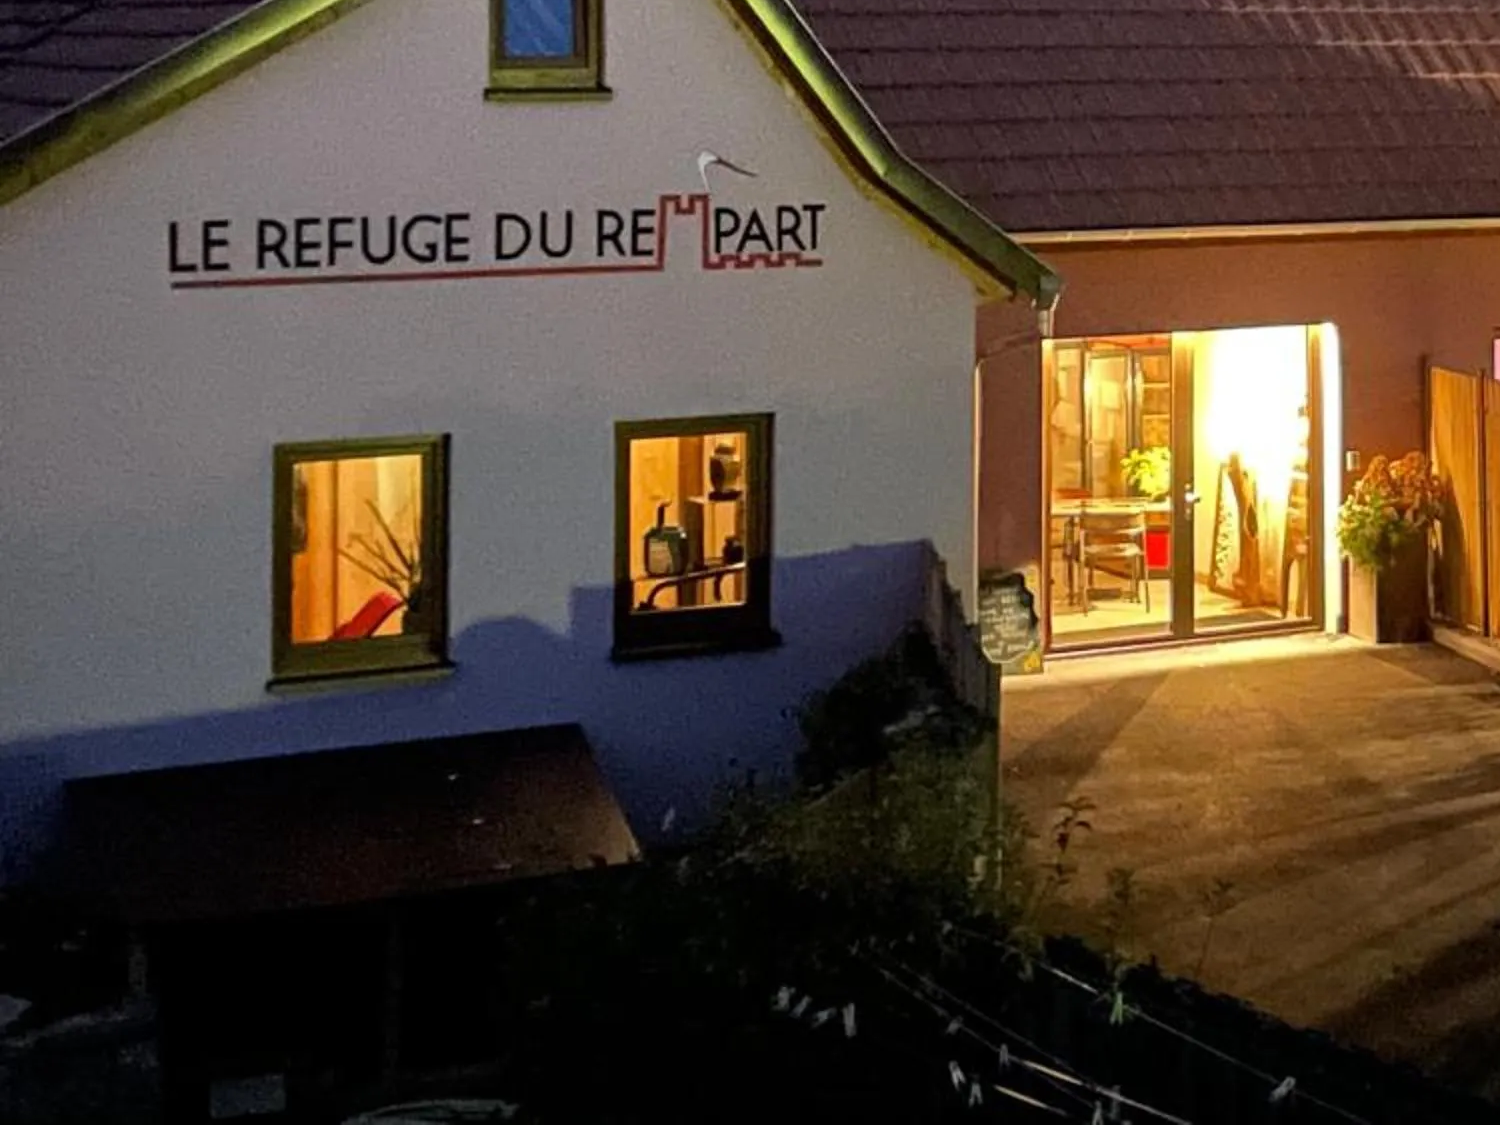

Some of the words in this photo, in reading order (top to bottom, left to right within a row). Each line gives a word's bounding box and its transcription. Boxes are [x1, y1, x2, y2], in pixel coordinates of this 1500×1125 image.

[168, 220, 231, 273] LE
[256, 213, 471, 270] REFUGE
[495, 209, 573, 261] DU
